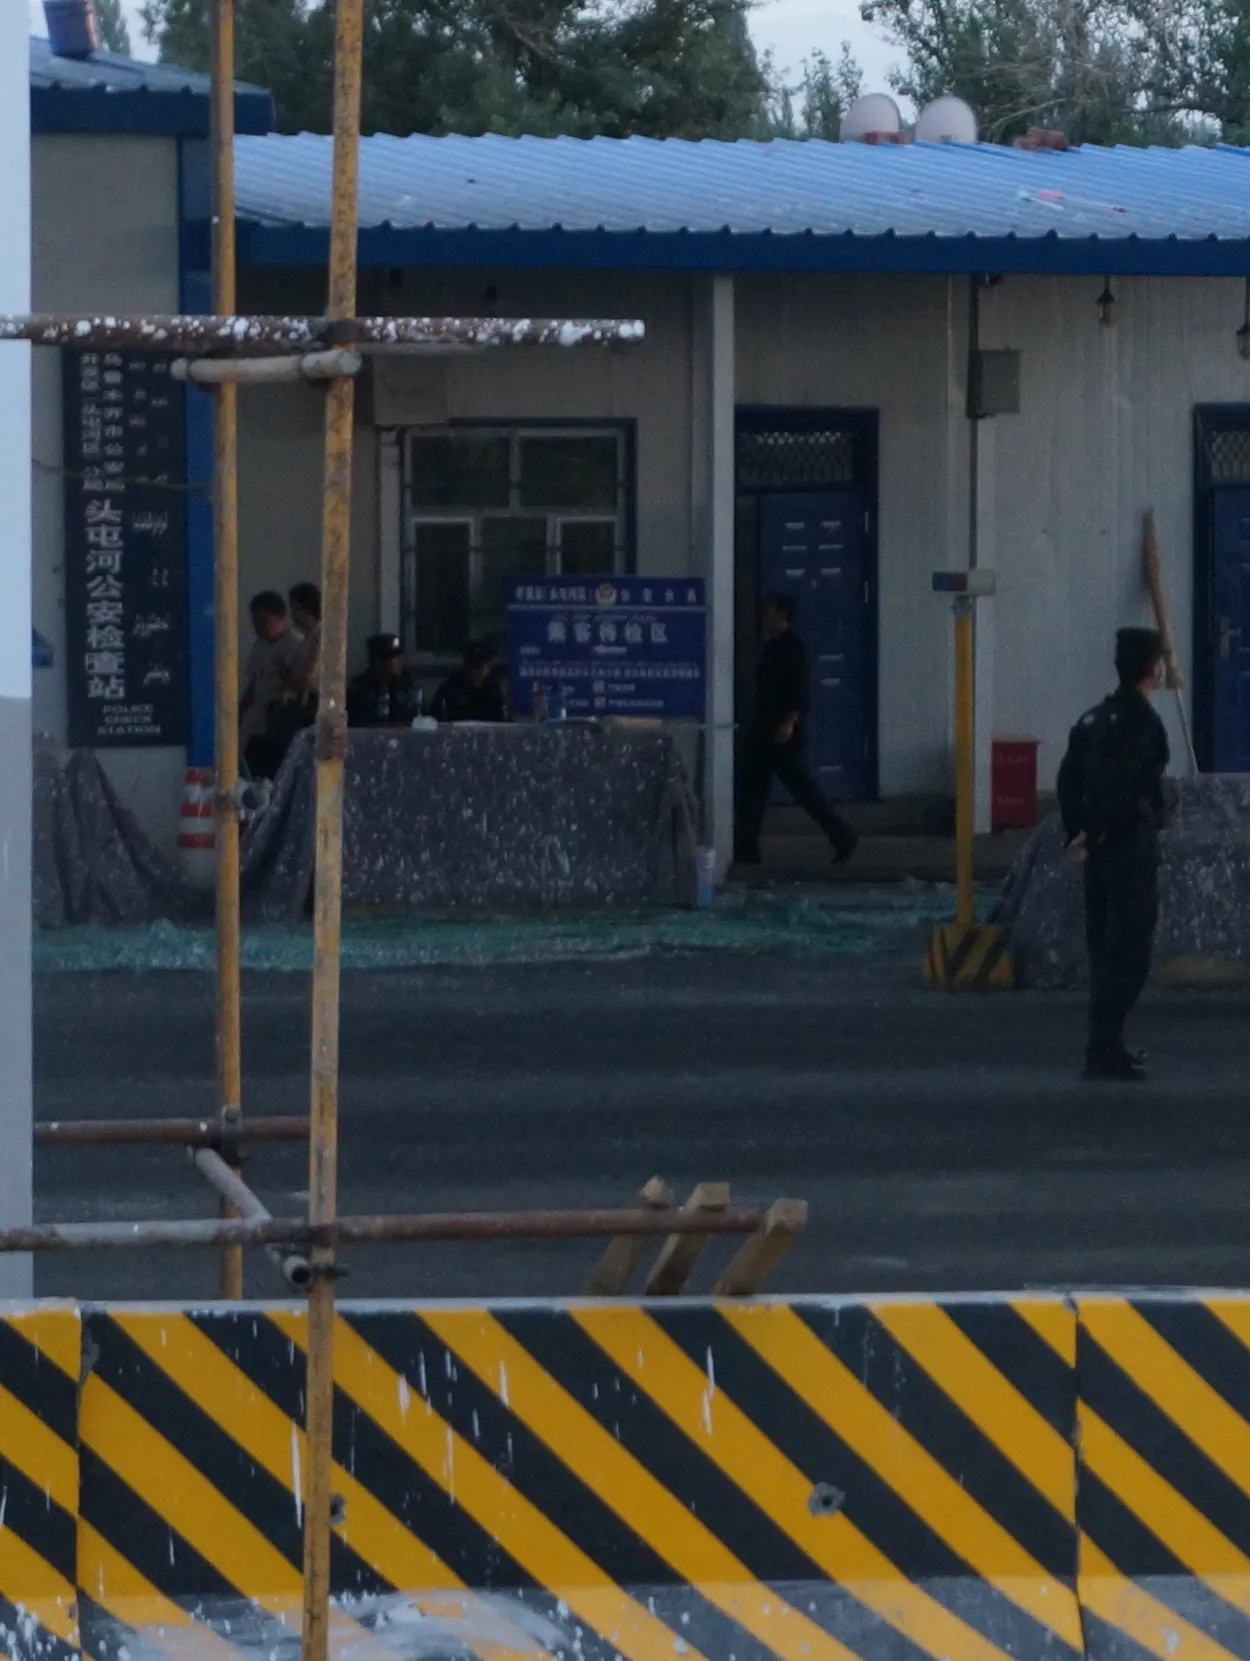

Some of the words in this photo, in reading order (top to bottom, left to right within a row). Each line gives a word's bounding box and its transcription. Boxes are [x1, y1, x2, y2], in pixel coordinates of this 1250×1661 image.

[84, 498, 126, 700] 头屯河公安检查站
